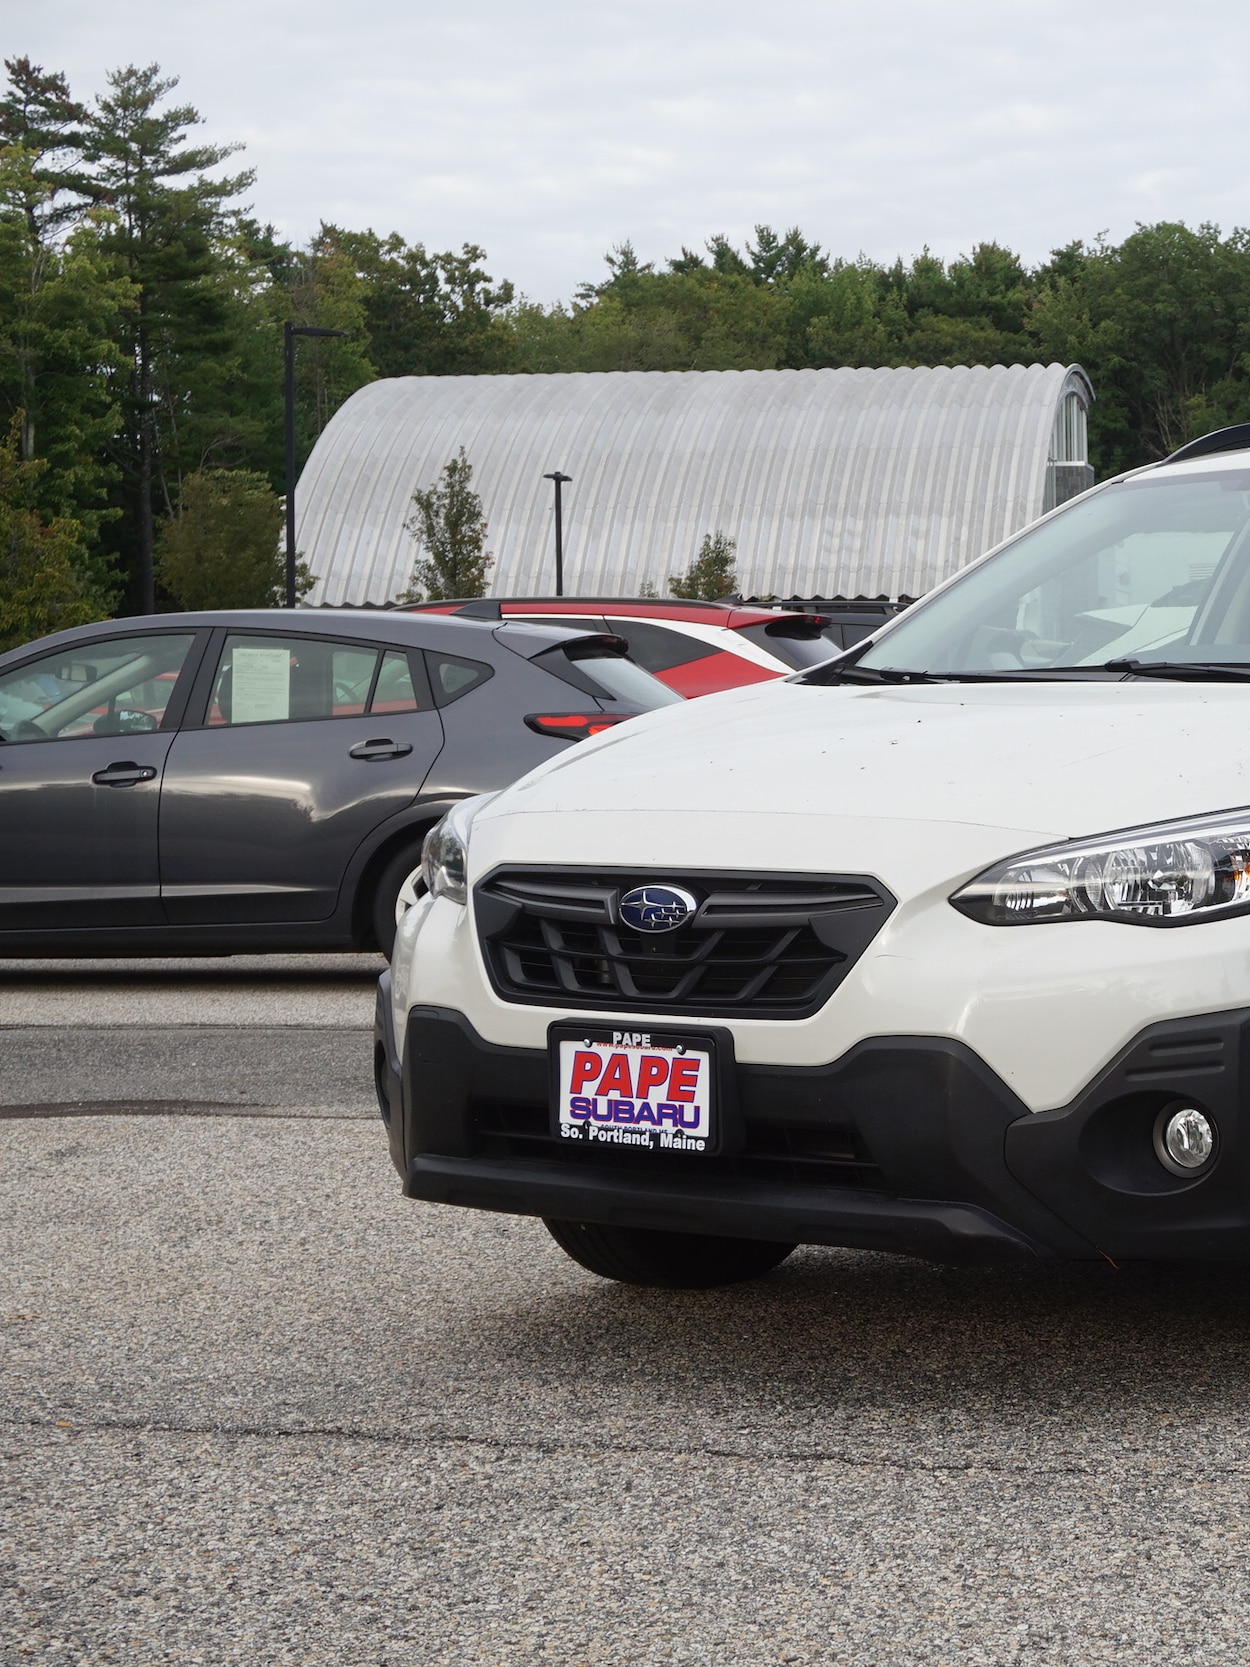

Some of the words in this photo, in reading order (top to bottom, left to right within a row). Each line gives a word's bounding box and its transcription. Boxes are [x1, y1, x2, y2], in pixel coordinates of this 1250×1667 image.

[613, 1031, 652, 1047] PAPE
[569, 1050, 701, 1103] PAPE
[569, 1096, 701, 1129] SUBARU
[560, 1123, 583, 1139] So.
[588, 1126, 655, 1149] Portland,
[660, 1132, 706, 1151] Maine
